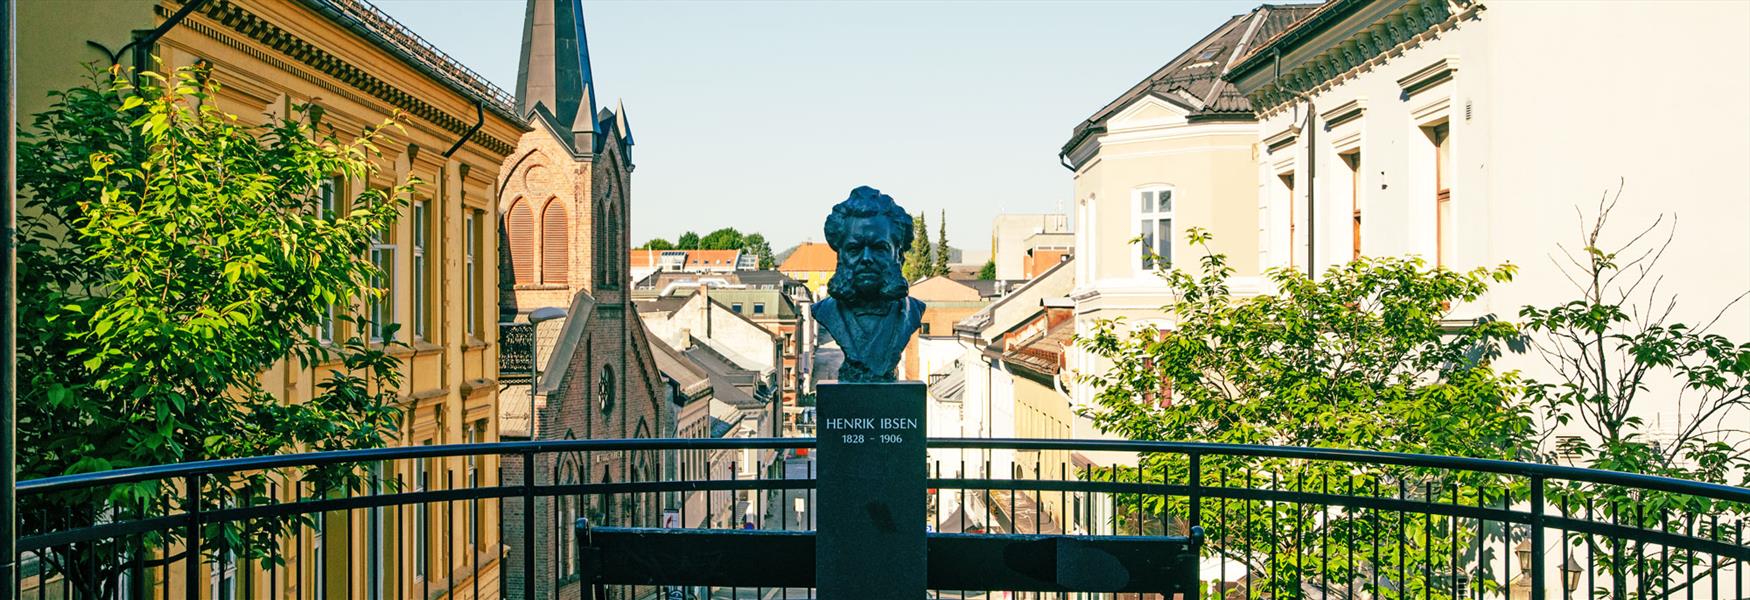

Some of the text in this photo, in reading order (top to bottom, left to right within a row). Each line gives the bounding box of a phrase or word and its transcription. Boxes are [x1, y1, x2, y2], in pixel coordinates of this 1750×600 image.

[827, 418, 917, 429] HENRIK IBSEN
[842, 434, 864, 443] 1828
[880, 434, 902, 443] 1906
